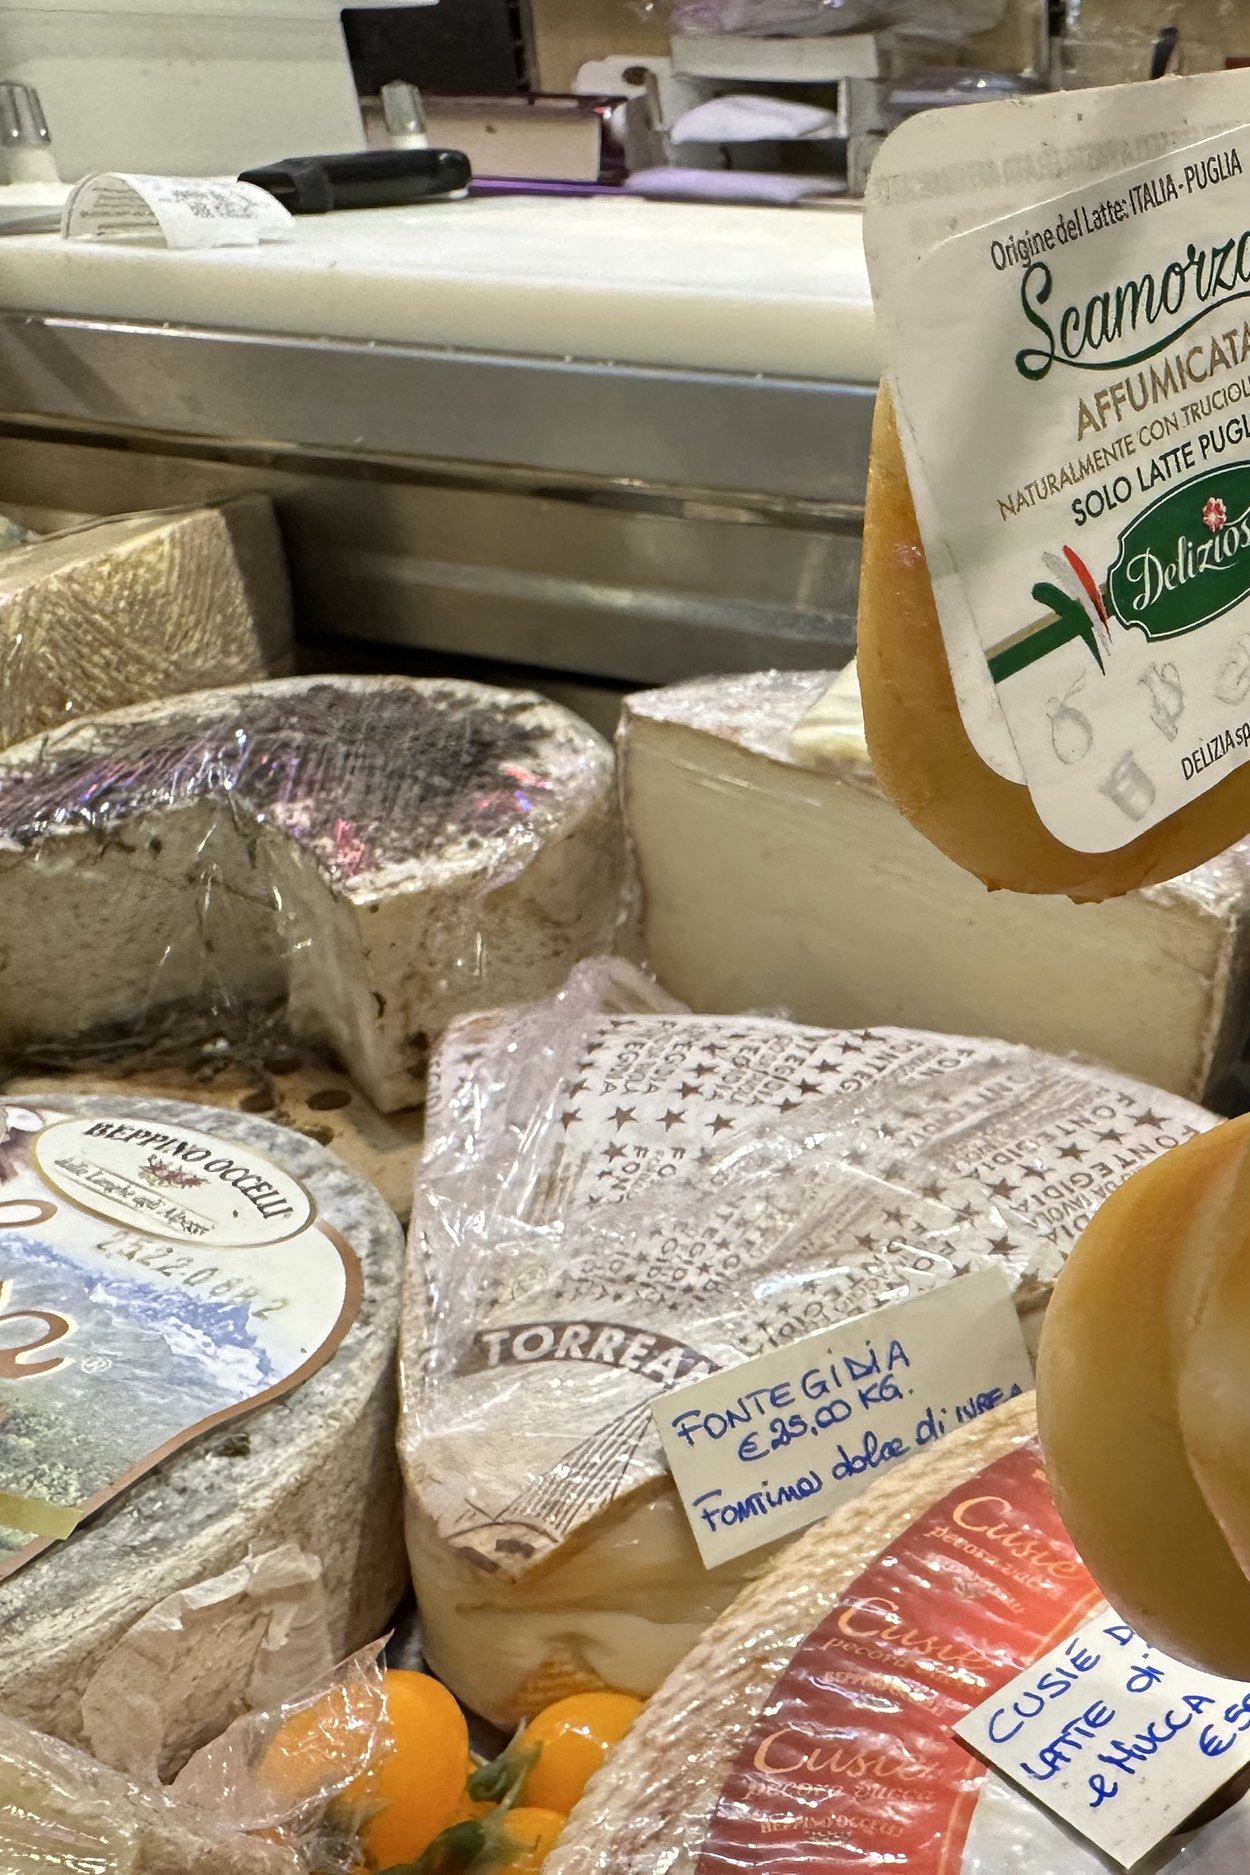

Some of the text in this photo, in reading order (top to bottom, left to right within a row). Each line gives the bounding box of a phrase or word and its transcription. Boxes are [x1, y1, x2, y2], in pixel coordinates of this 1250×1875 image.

[990, 227, 1056, 271] Origine
[1055, 208, 1083, 246] del
[1082, 199, 1130, 233] Latte:
[1129, 174, 1178, 215] ITALIA
[1184, 148, 1243, 193] PUGLIA
[996, 434, 1137, 521] NATURALMENTE
[1137, 411, 1179, 447] CON
[1071, 476, 1132, 526] SOLO
[1136, 441, 1196, 493] LATTE
[1181, 730, 1236, 781] DELIZIA
[82, 1121, 293, 1220] BEPPINO OCCELLI
[916, 1407, 947, 1446] di
[1020, 1652, 1165, 1780] LATTE di
